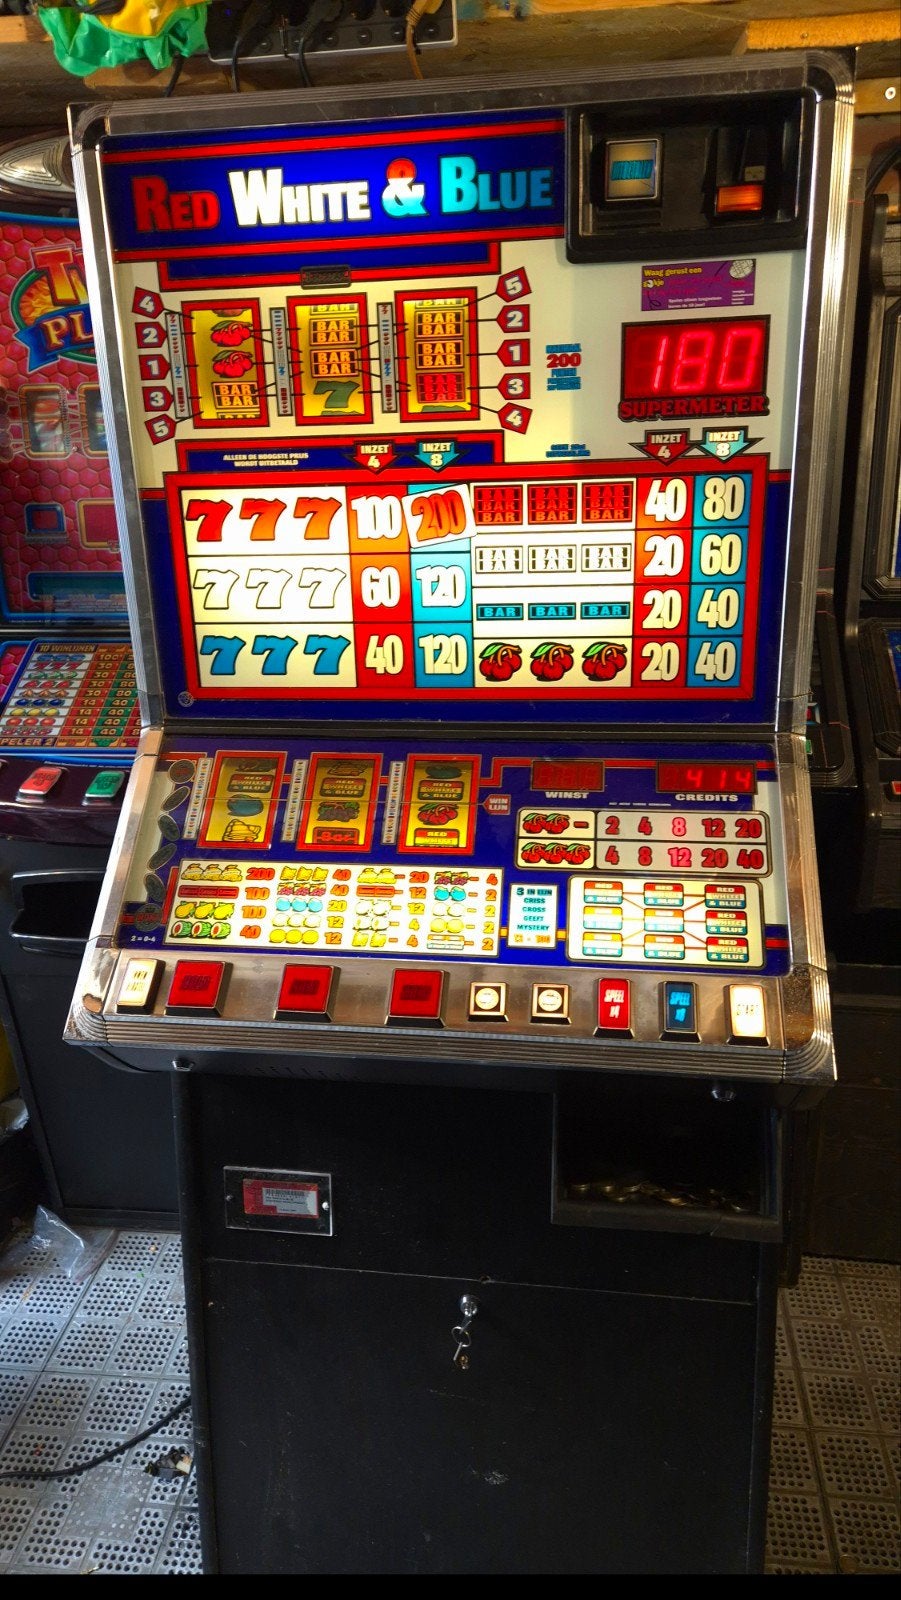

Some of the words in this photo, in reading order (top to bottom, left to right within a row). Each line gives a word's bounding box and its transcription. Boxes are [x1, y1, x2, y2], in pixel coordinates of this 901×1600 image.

[382, 158, 430, 217] &
[644, 269, 664, 277] Waag
[665, 267, 688, 276] gerust
[504, 275, 522, 296] 5
[139, 296, 154, 312] 4
[422, 312, 455, 323] BAR
[506, 310, 523, 328] 2
[316, 320, 349, 331] BAR
[422, 324, 456, 335] BAR
[143, 328, 158, 343] 2
[317, 332, 349, 342] BAR
[422, 342, 456, 354] BAR
[509, 346, 521, 362] 1
[318, 352, 350, 362] BAR
[423, 354, 456, 366] BAR
[546, 353, 581, 368] 200
[652, 328, 762, 392] 180
[148, 358, 158, 374] 1
[318, 364, 351, 374] BAR
[220, 384, 251, 394] BAR
[508, 378, 524, 395] 3
[150, 392, 164, 406] 3
[222, 396, 253, 406] BAR
[314, 381, 360, 408] 7
[619, 396, 766, 419] SUPERMETER
[506, 410, 522, 427] 4
[153, 420, 168, 437] 5
[651, 434, 682, 443] INZET
[709, 431, 740, 442] INZET
[360, 444, 389, 454] INZET
[422, 442, 452, 452] INZET
[658, 445, 671, 459] 4
[716, 442, 730, 456] 8
[368, 456, 380, 468] 4
[430, 454, 443, 466] 8
[645, 478, 687, 522] 40
[703, 476, 745, 521] 80
[186, 499, 233, 542] 7
[239, 498, 287, 540] 7
[293, 497, 342, 540] 7
[351, 495, 402, 540] 100
[411, 490, 467, 542] 200
[482, 512, 515, 522] BAR
[536, 510, 569, 521] BAR
[590, 510, 624, 519] BAR
[644, 534, 684, 576] 20
[700, 533, 742, 576] 60
[193, 569, 240, 609] 7
[245, 568, 293, 609] 7
[298, 568, 346, 608] 7
[361, 566, 400, 608] 60
[415, 564, 466, 607] 120
[484, 607, 515, 617] BAR
[536, 606, 568, 616] BAR
[589, 606, 622, 616] BAR
[642, 589, 682, 629] 20
[697, 588, 739, 629] 40
[200, 635, 246, 675] 7
[251, 635, 298, 675] 7
[303, 635, 351, 675] 7
[365, 634, 404, 674] 40
[418, 633, 468, 675] 120
[641, 641, 680, 681] 20
[694, 641, 736, 681] 40
[687, 769, 752, 789] 414
[675, 794, 738, 802] CREDITS
[605, 816, 620, 835] 2
[638, 816, 652, 835] 4
[672, 818, 687, 836] 8
[702, 818, 726, 838] 12
[735, 819, 762, 838] 20
[605, 846, 619, 865] 4
[638, 846, 652, 866] 8
[668, 848, 692, 868] 12
[701, 848, 728, 868] 20
[737, 849, 764, 869] 40
[246, 867, 275, 880] 200
[332, 869, 351, 881] 40
[409, 871, 429, 884] 20
[486, 873, 498, 885] 4
[245, 886, 270, 900] 100
[330, 884, 349, 896] 40
[409, 887, 426, 899] 12
[486, 889, 497, 901] 2
[516, 887, 524, 895] 3
[242, 906, 266, 919] 100
[327, 900, 347, 912] 20
[407, 903, 425, 915] 12
[485, 905, 496, 917] 2
[327, 916, 344, 928] 12
[409, 919, 420, 930] 4
[483, 921, 494, 934] 2
[240, 925, 261, 939] 40
[325, 932, 342, 945] 12
[407, 935, 418, 947] 4
[482, 938, 494, 950] 2
[604, 989, 624, 1003] SPEEL
[670, 992, 690, 1006] SPEEL
